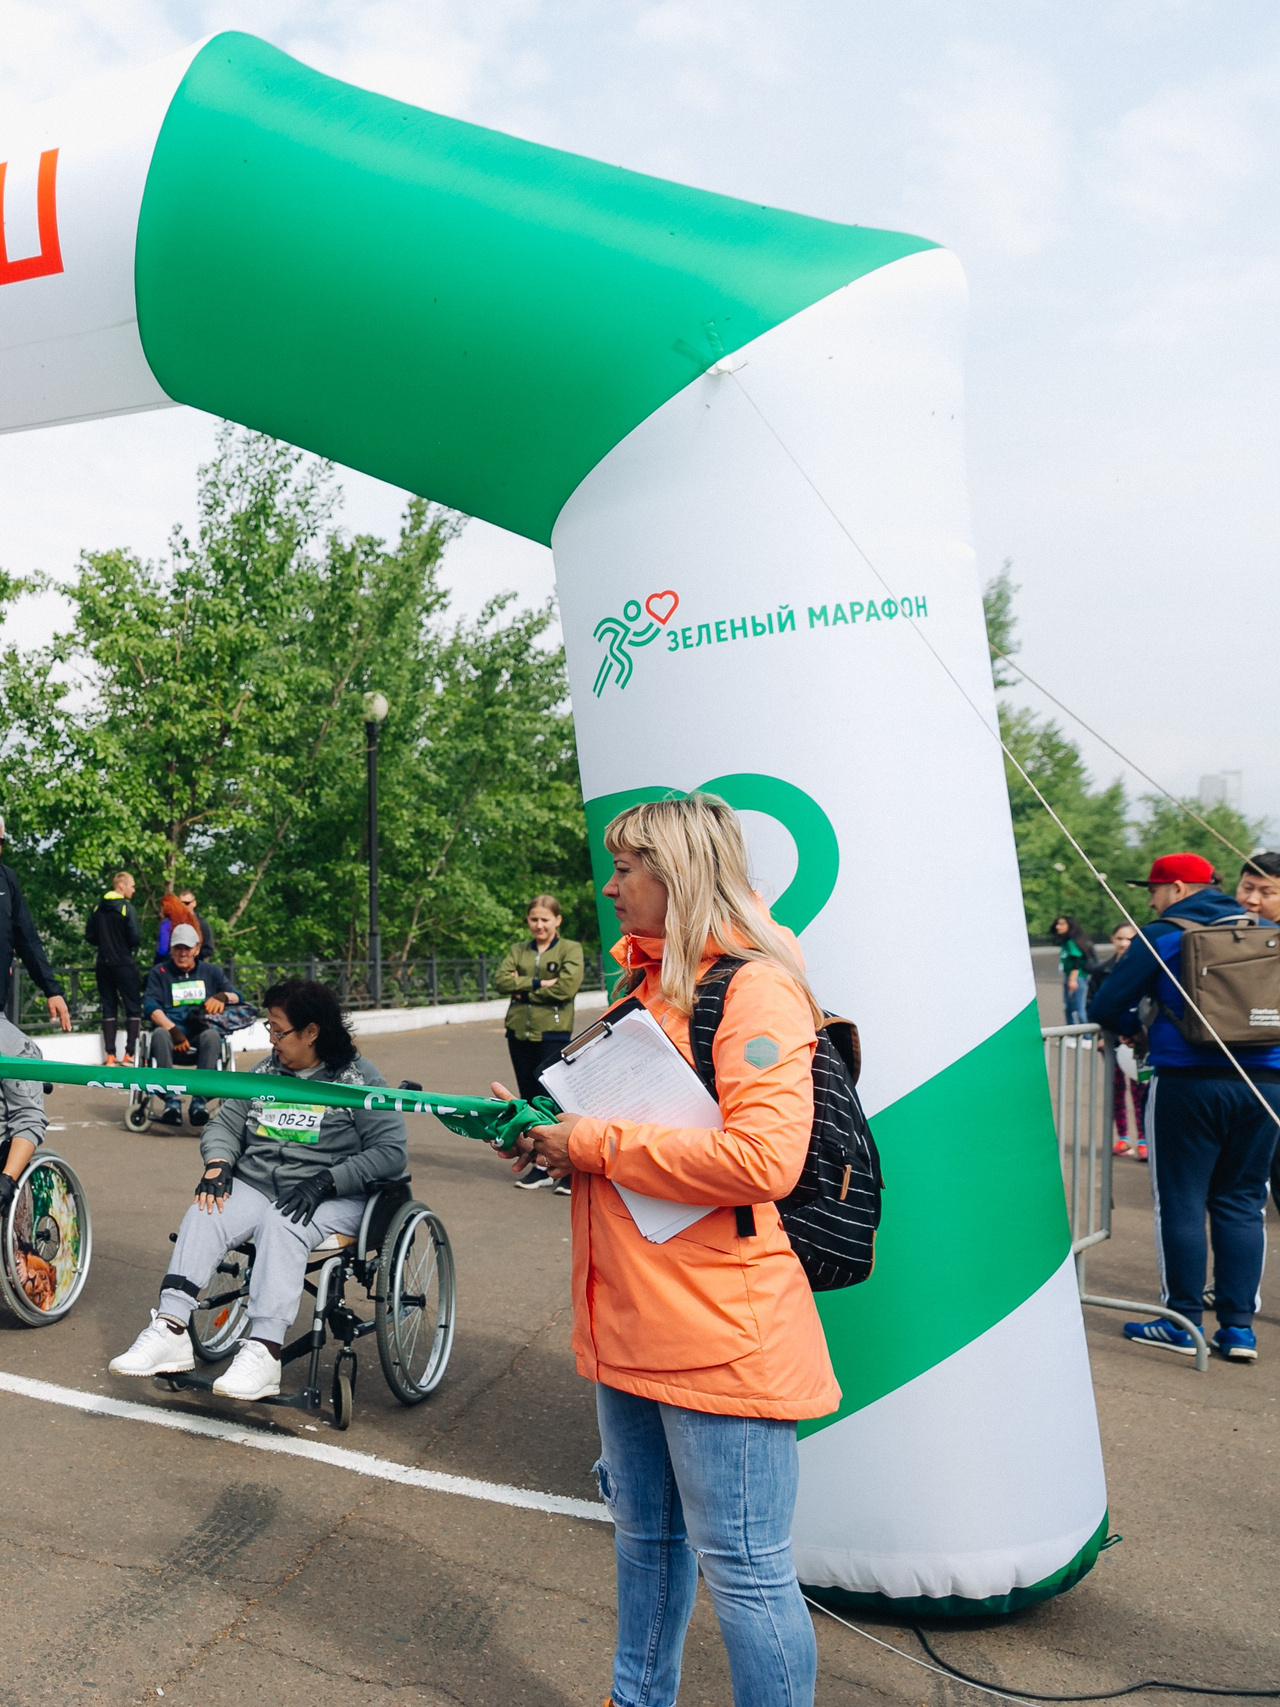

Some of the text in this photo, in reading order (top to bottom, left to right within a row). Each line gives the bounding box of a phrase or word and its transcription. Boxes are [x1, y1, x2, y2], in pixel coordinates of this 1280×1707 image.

[666, 595, 929, 652] ЗЕЛЕНЫЙ МАРАФОН
[278, 1113, 318, 1127] 0625
